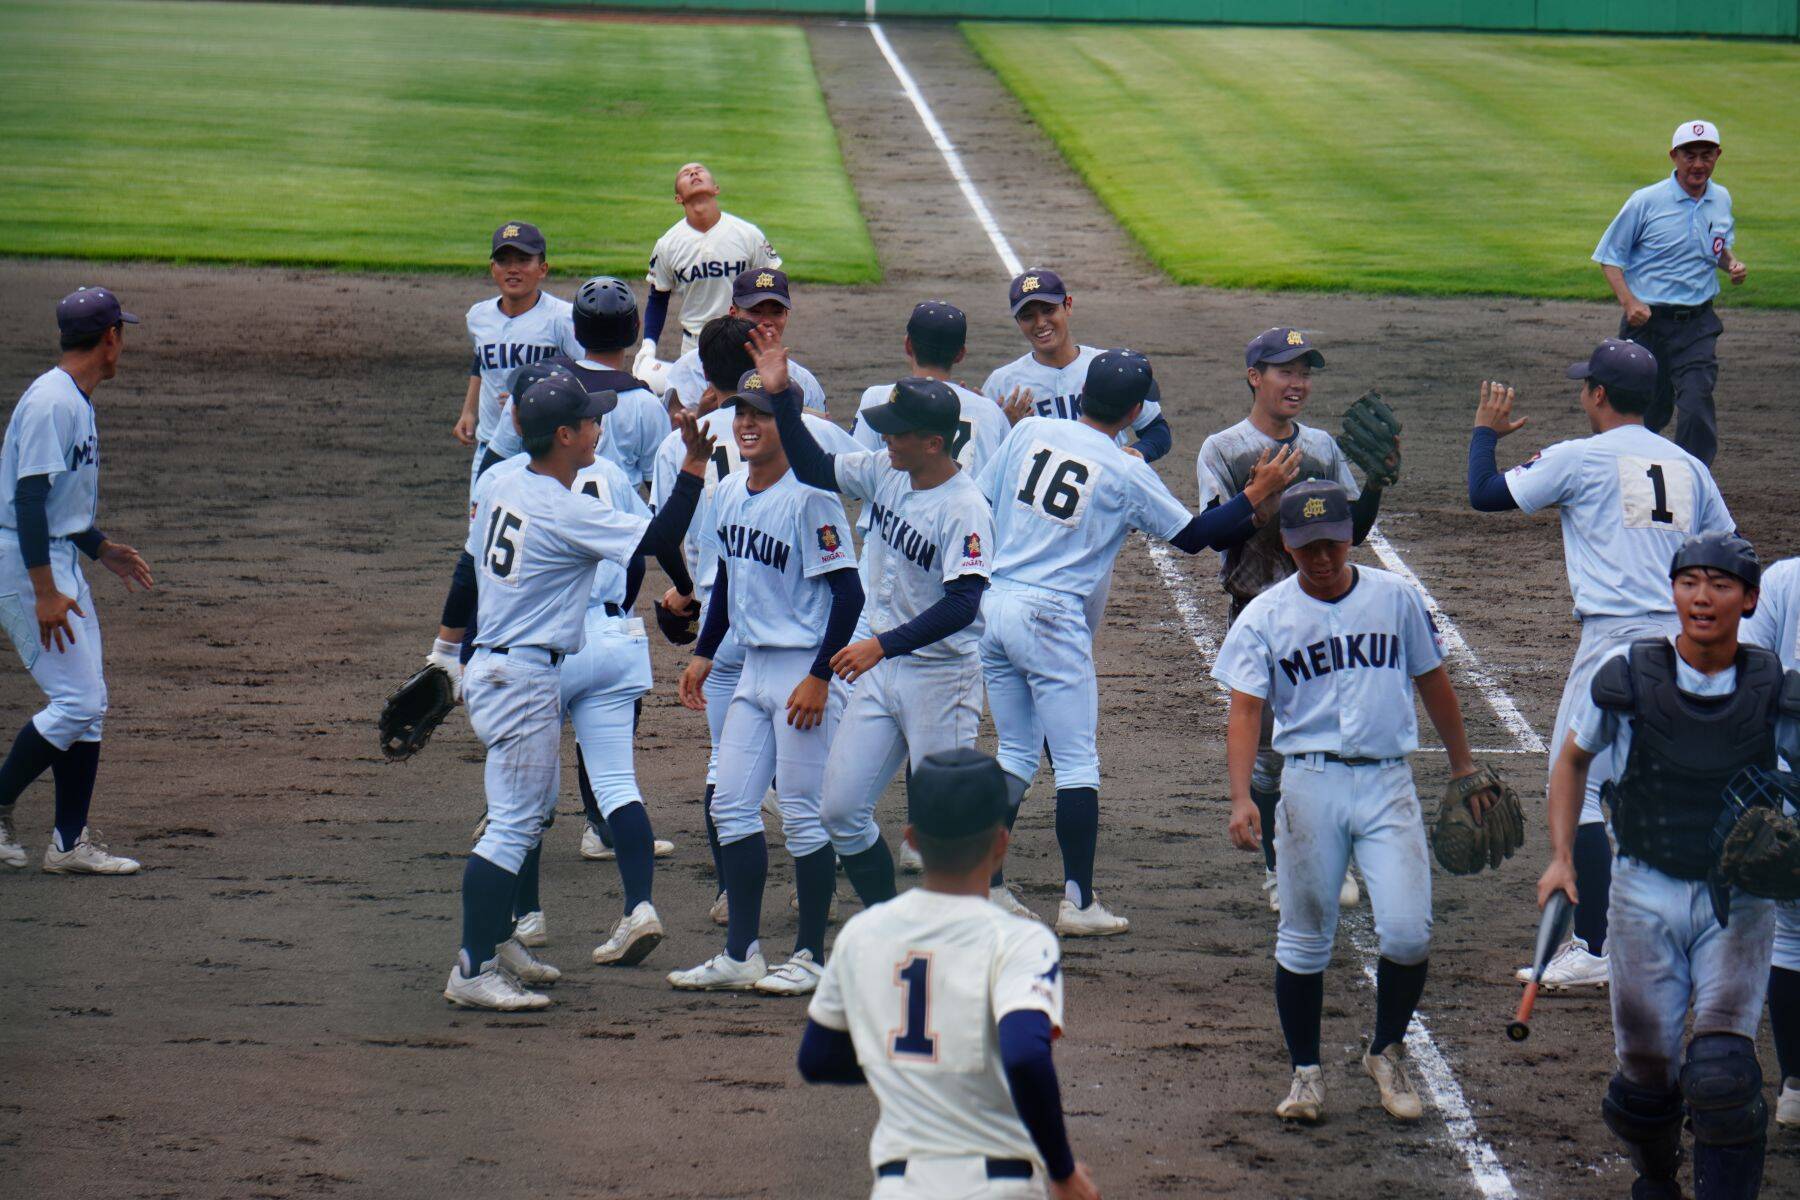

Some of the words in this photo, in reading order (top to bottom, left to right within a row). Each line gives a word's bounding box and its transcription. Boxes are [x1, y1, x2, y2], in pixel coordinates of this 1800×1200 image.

[674, 260, 747, 283] KAISHI
[478, 343, 557, 370] EIKU
[1017, 448, 1089, 520] 16
[1646, 463, 1673, 524] 1
[484, 505, 522, 578] 15
[888, 949, 939, 1063] 1
